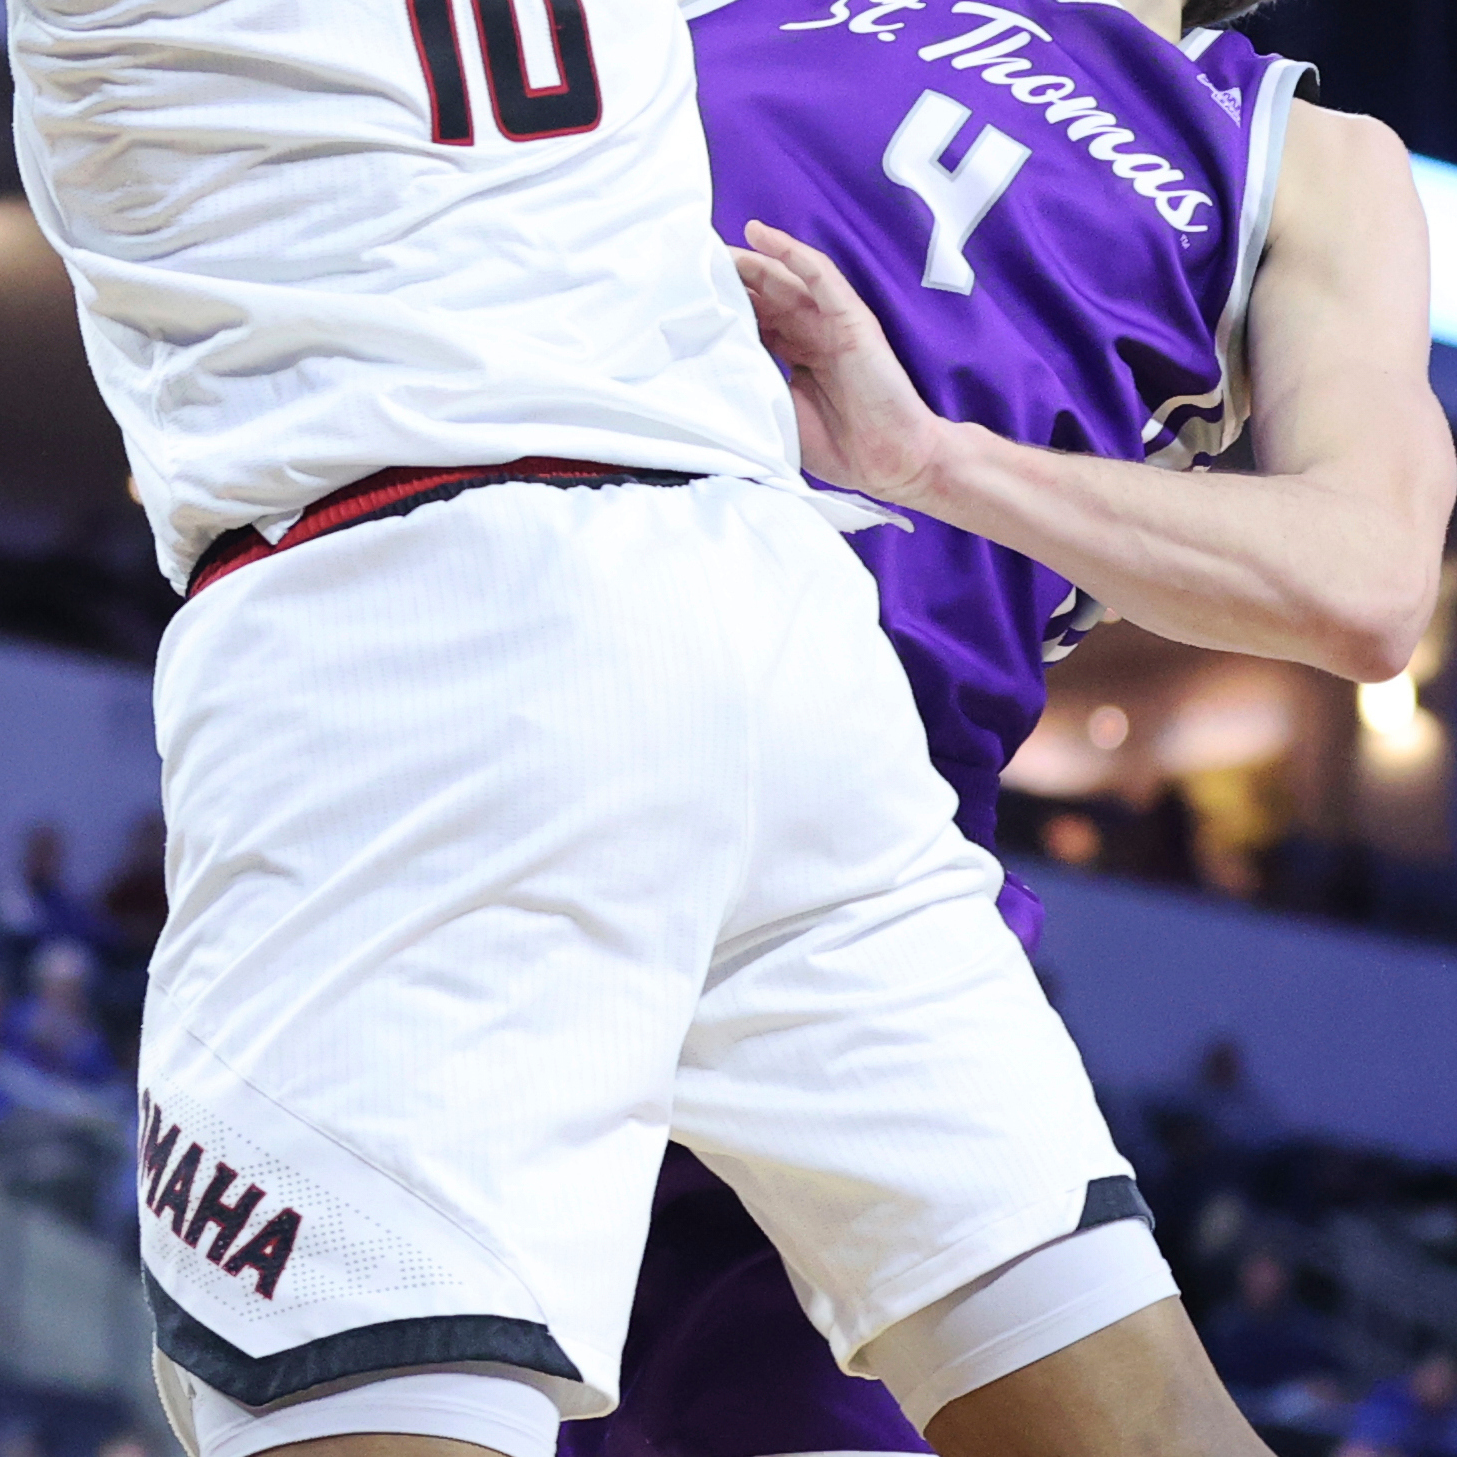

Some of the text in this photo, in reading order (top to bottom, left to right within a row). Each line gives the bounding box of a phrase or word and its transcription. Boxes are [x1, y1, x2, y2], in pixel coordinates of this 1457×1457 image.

[881, 88, 1034, 297] 4
[917, 0, 1214, 234] Thomas
[140, 1087, 303, 1301] MAHA
